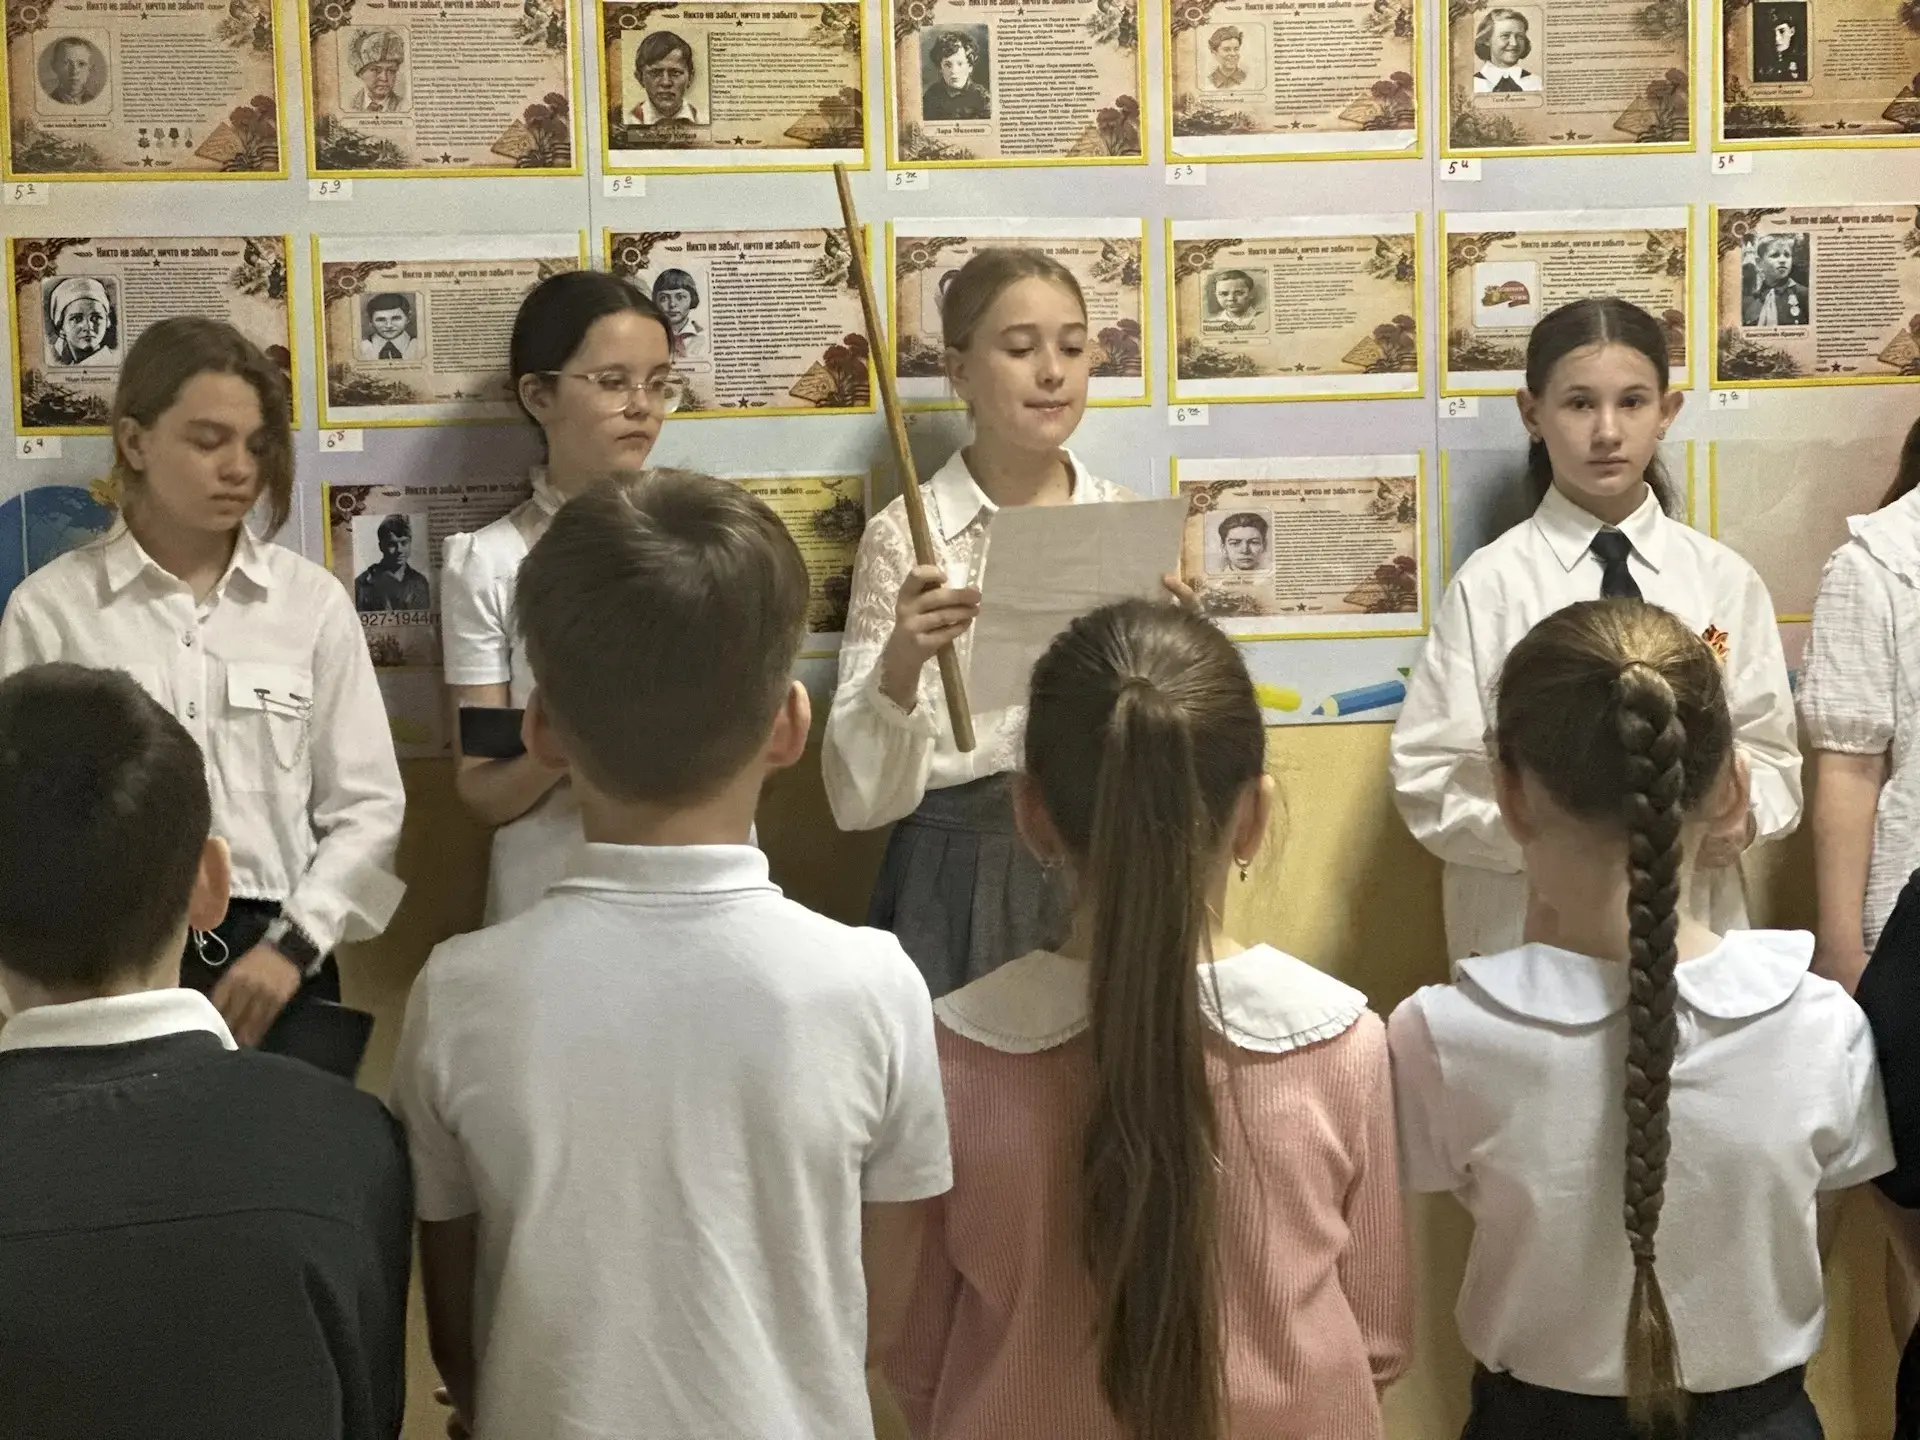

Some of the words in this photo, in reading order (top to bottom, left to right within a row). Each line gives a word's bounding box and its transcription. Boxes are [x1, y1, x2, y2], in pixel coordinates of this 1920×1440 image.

[86, 2, 108, 11] Никто
[120, 1, 144, 11] забыт,
[178, 0, 204, 10] забыто
[684, 11, 704, 19] Никто
[716, 11, 738, 19] забыт,
[686, 242, 707, 251] Никто
[708, 243, 717, 251] не
[718, 241, 741, 252] забыт,
[775, 240, 800, 250] забыто
[96, 247, 118, 257] Никто
[120, 249, 129, 257] не
[131, 247, 156, 258] забыт,
[158, 249, 179, 257] ничто
[181, 249, 189, 257] не
[191, 247, 218, 257] забыто
[360, 612, 429, 626] 927-1944
